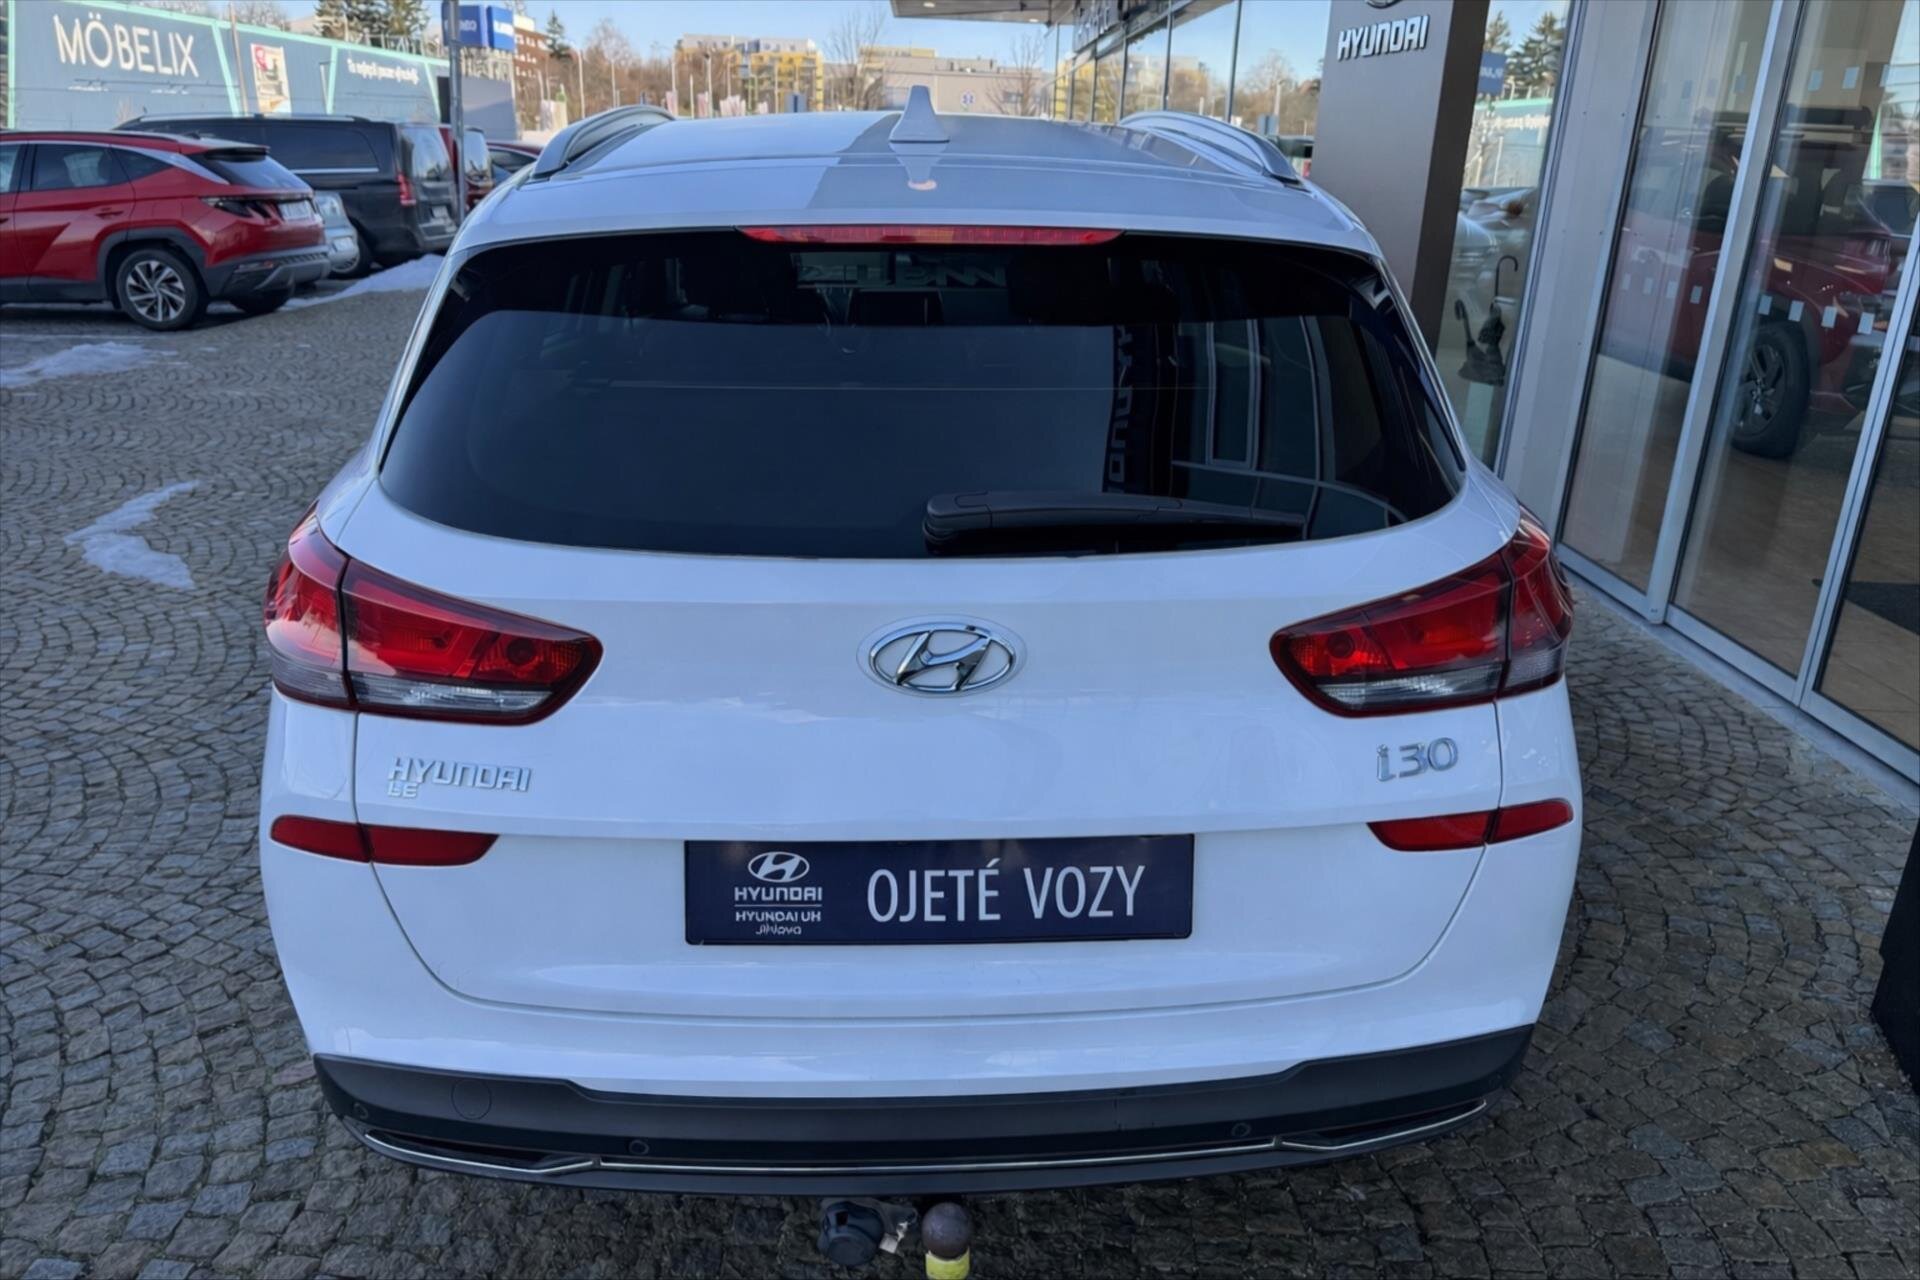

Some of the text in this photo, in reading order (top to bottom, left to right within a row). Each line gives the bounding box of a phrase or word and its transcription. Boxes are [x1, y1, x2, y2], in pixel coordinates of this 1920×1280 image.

[52, 12, 199, 78] MÖBELIX
[1337, 14, 1430, 62] HYUNDAI
[387, 757, 532, 792] HYUNDAI
[1376, 737, 1459, 782] i30
[734, 887, 823, 901] HYUNDAI
[867, 858, 1146, 923] OJETÉ VOZY
[735, 911, 798, 922] HYUNDAI
